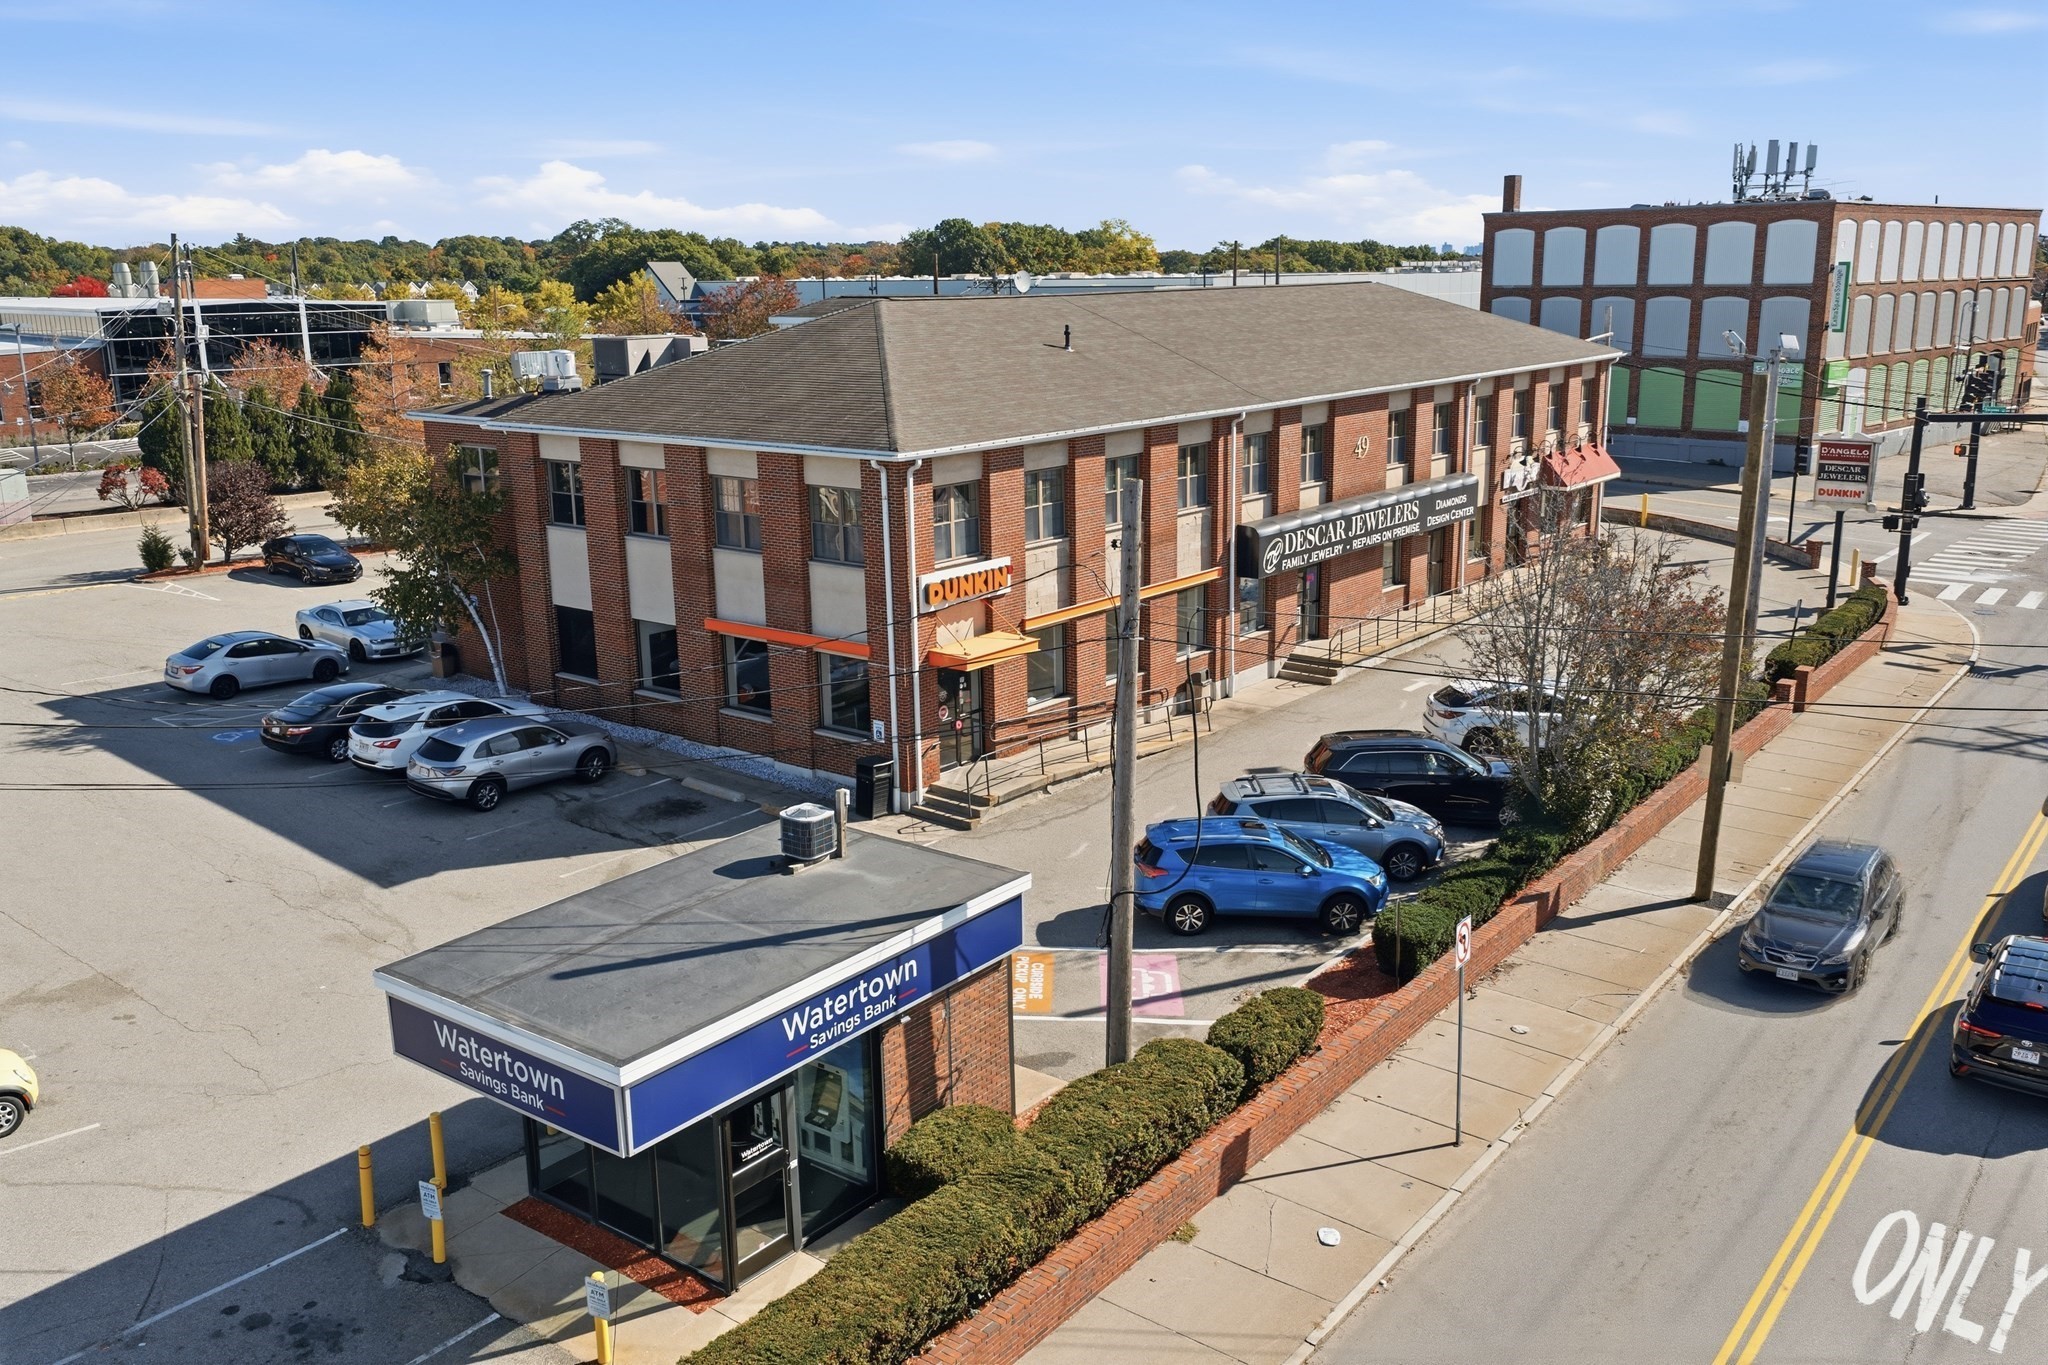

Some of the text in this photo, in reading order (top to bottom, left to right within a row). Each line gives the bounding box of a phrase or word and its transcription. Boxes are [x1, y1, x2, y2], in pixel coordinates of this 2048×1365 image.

[1355, 435, 1369, 458] 49
[1821, 446, 1869, 456] D'ANGELO
[1818, 472, 1867, 481] JEWELERS
[1825, 464, 1861, 473] DESCAR
[1435, 494, 1467, 510] DIAMONDS
[1818, 487, 1865, 498] DUNKIN'
[1284, 500, 1419, 555] DESCAR JEWELERS
[1427, 506, 1474, 527] DESIGN CENTER
[1281, 553, 1309, 571] FAMILY
[1309, 544, 1344, 563] JEWELRY
[1352, 534, 1381, 550] REPAIRS
[1382, 529, 1392, 541] ON
[1392, 522, 1420, 538] PREMISE
[928, 565, 1013, 606] DUNKIN'
[1012, 956, 1030, 1009] PICKUP ONLY
[1029, 962, 1045, 999] CURBSIDE
[782, 959, 918, 1042] Watertown
[809, 994, 897, 1049] Savings Bank
[433, 1020, 565, 1100] Watertown
[460, 1061, 544, 1111] Savings Bank
[741, 1137, 773, 1158] Watertown
[423, 1192, 436, 1200] ATM
[591, 1289, 605, 1298] ATM
[1852, 1210, 2048, 1354] ONLY
